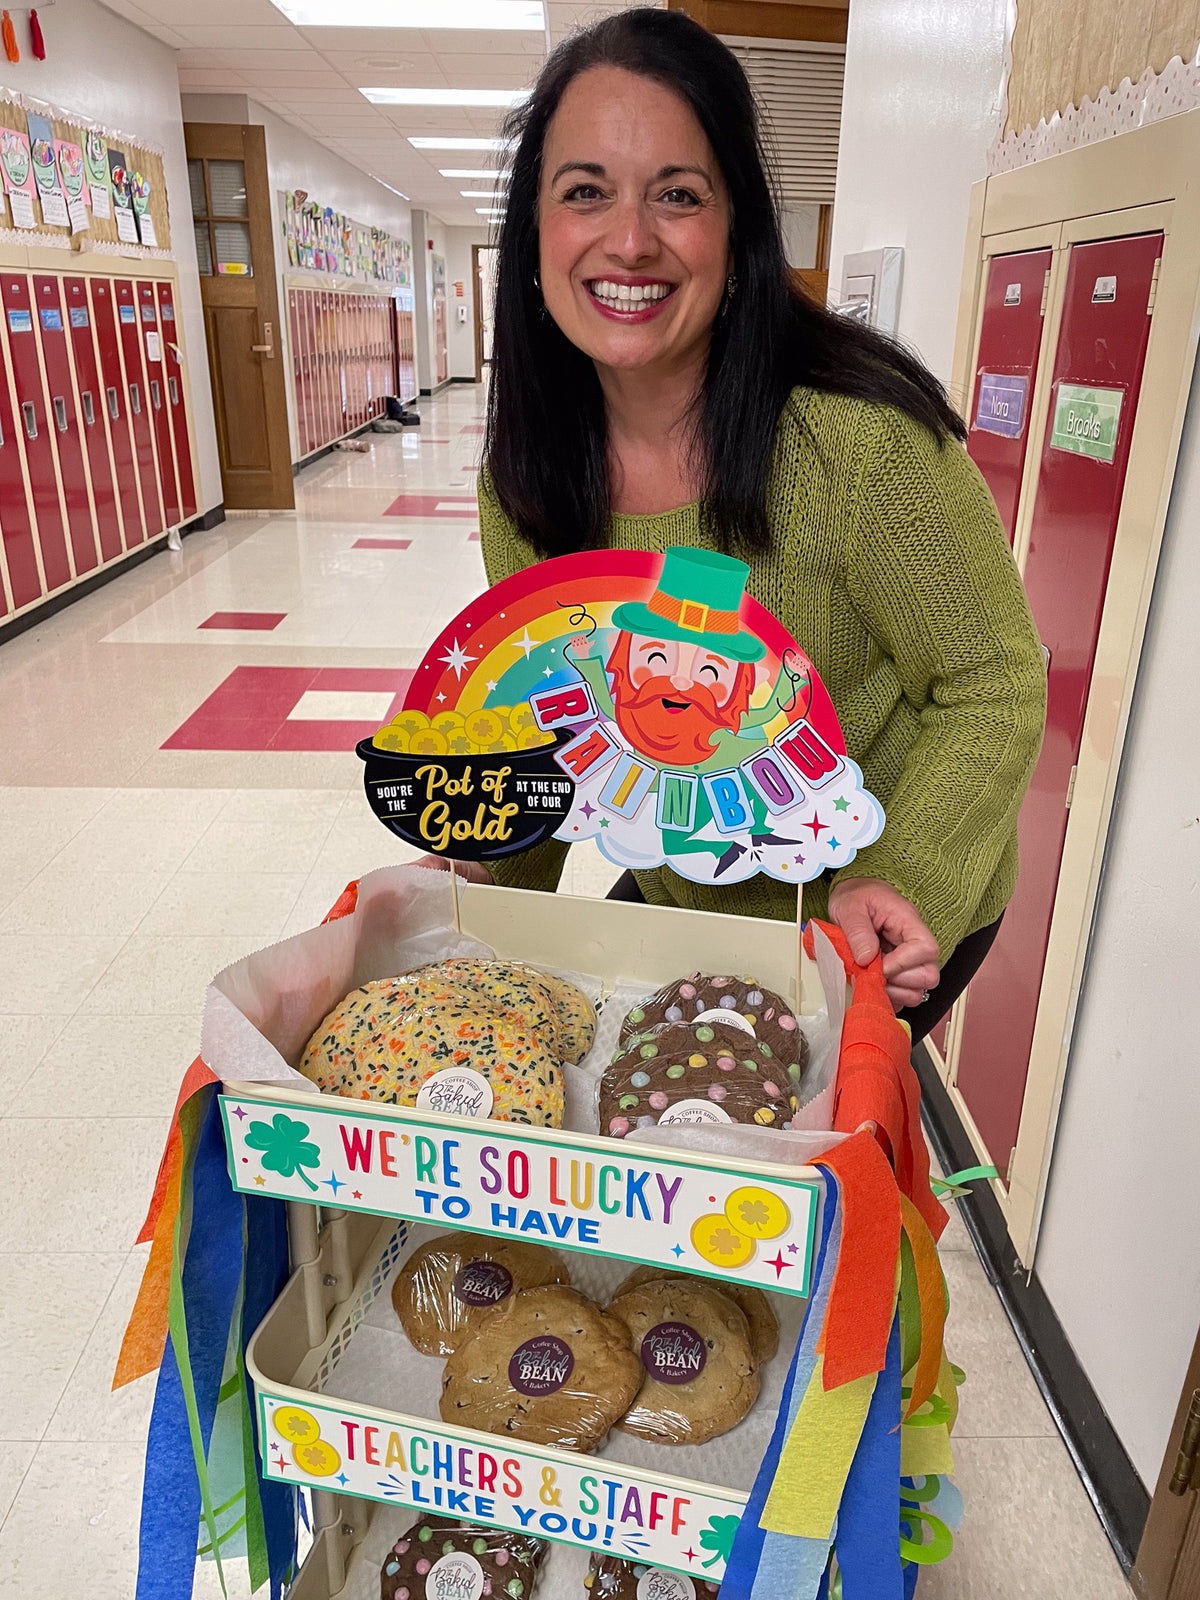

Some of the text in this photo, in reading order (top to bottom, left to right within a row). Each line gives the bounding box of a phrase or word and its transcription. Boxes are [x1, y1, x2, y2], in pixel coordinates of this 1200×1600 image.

[991, 395, 1009, 417] Nora
[1067, 410, 1100, 439] Brooks
[536, 687, 837, 828] RAINBOW
[377, 785, 413, 799] YOU'RE
[415, 764, 512, 803] Pot of
[516, 781, 571, 794] AT THE END
[387, 799, 407, 812] THE
[527, 795, 561, 808] OF OUR
[419, 800, 519, 851] Gold
[431, 1097, 478, 1117] BEAN
[703, 1112, 718, 1122] SHOP
[339, 1124, 683, 1224] WE'RE SO LUCKY
[415, 1189, 600, 1244] TO HAVE
[462, 1279, 505, 1301] BEAN
[643, 1335, 702, 1359] Baked
[512, 1349, 569, 1372] Baked
[655, 1351, 701, 1370] BEAN
[520, 1365, 567, 1383] BEAN
[341, 1421, 691, 1536] TEACHERS & STAFF
[411, 1480, 614, 1546] LIKE YOU!
[437, 1582, 473, 1599] BEAN
